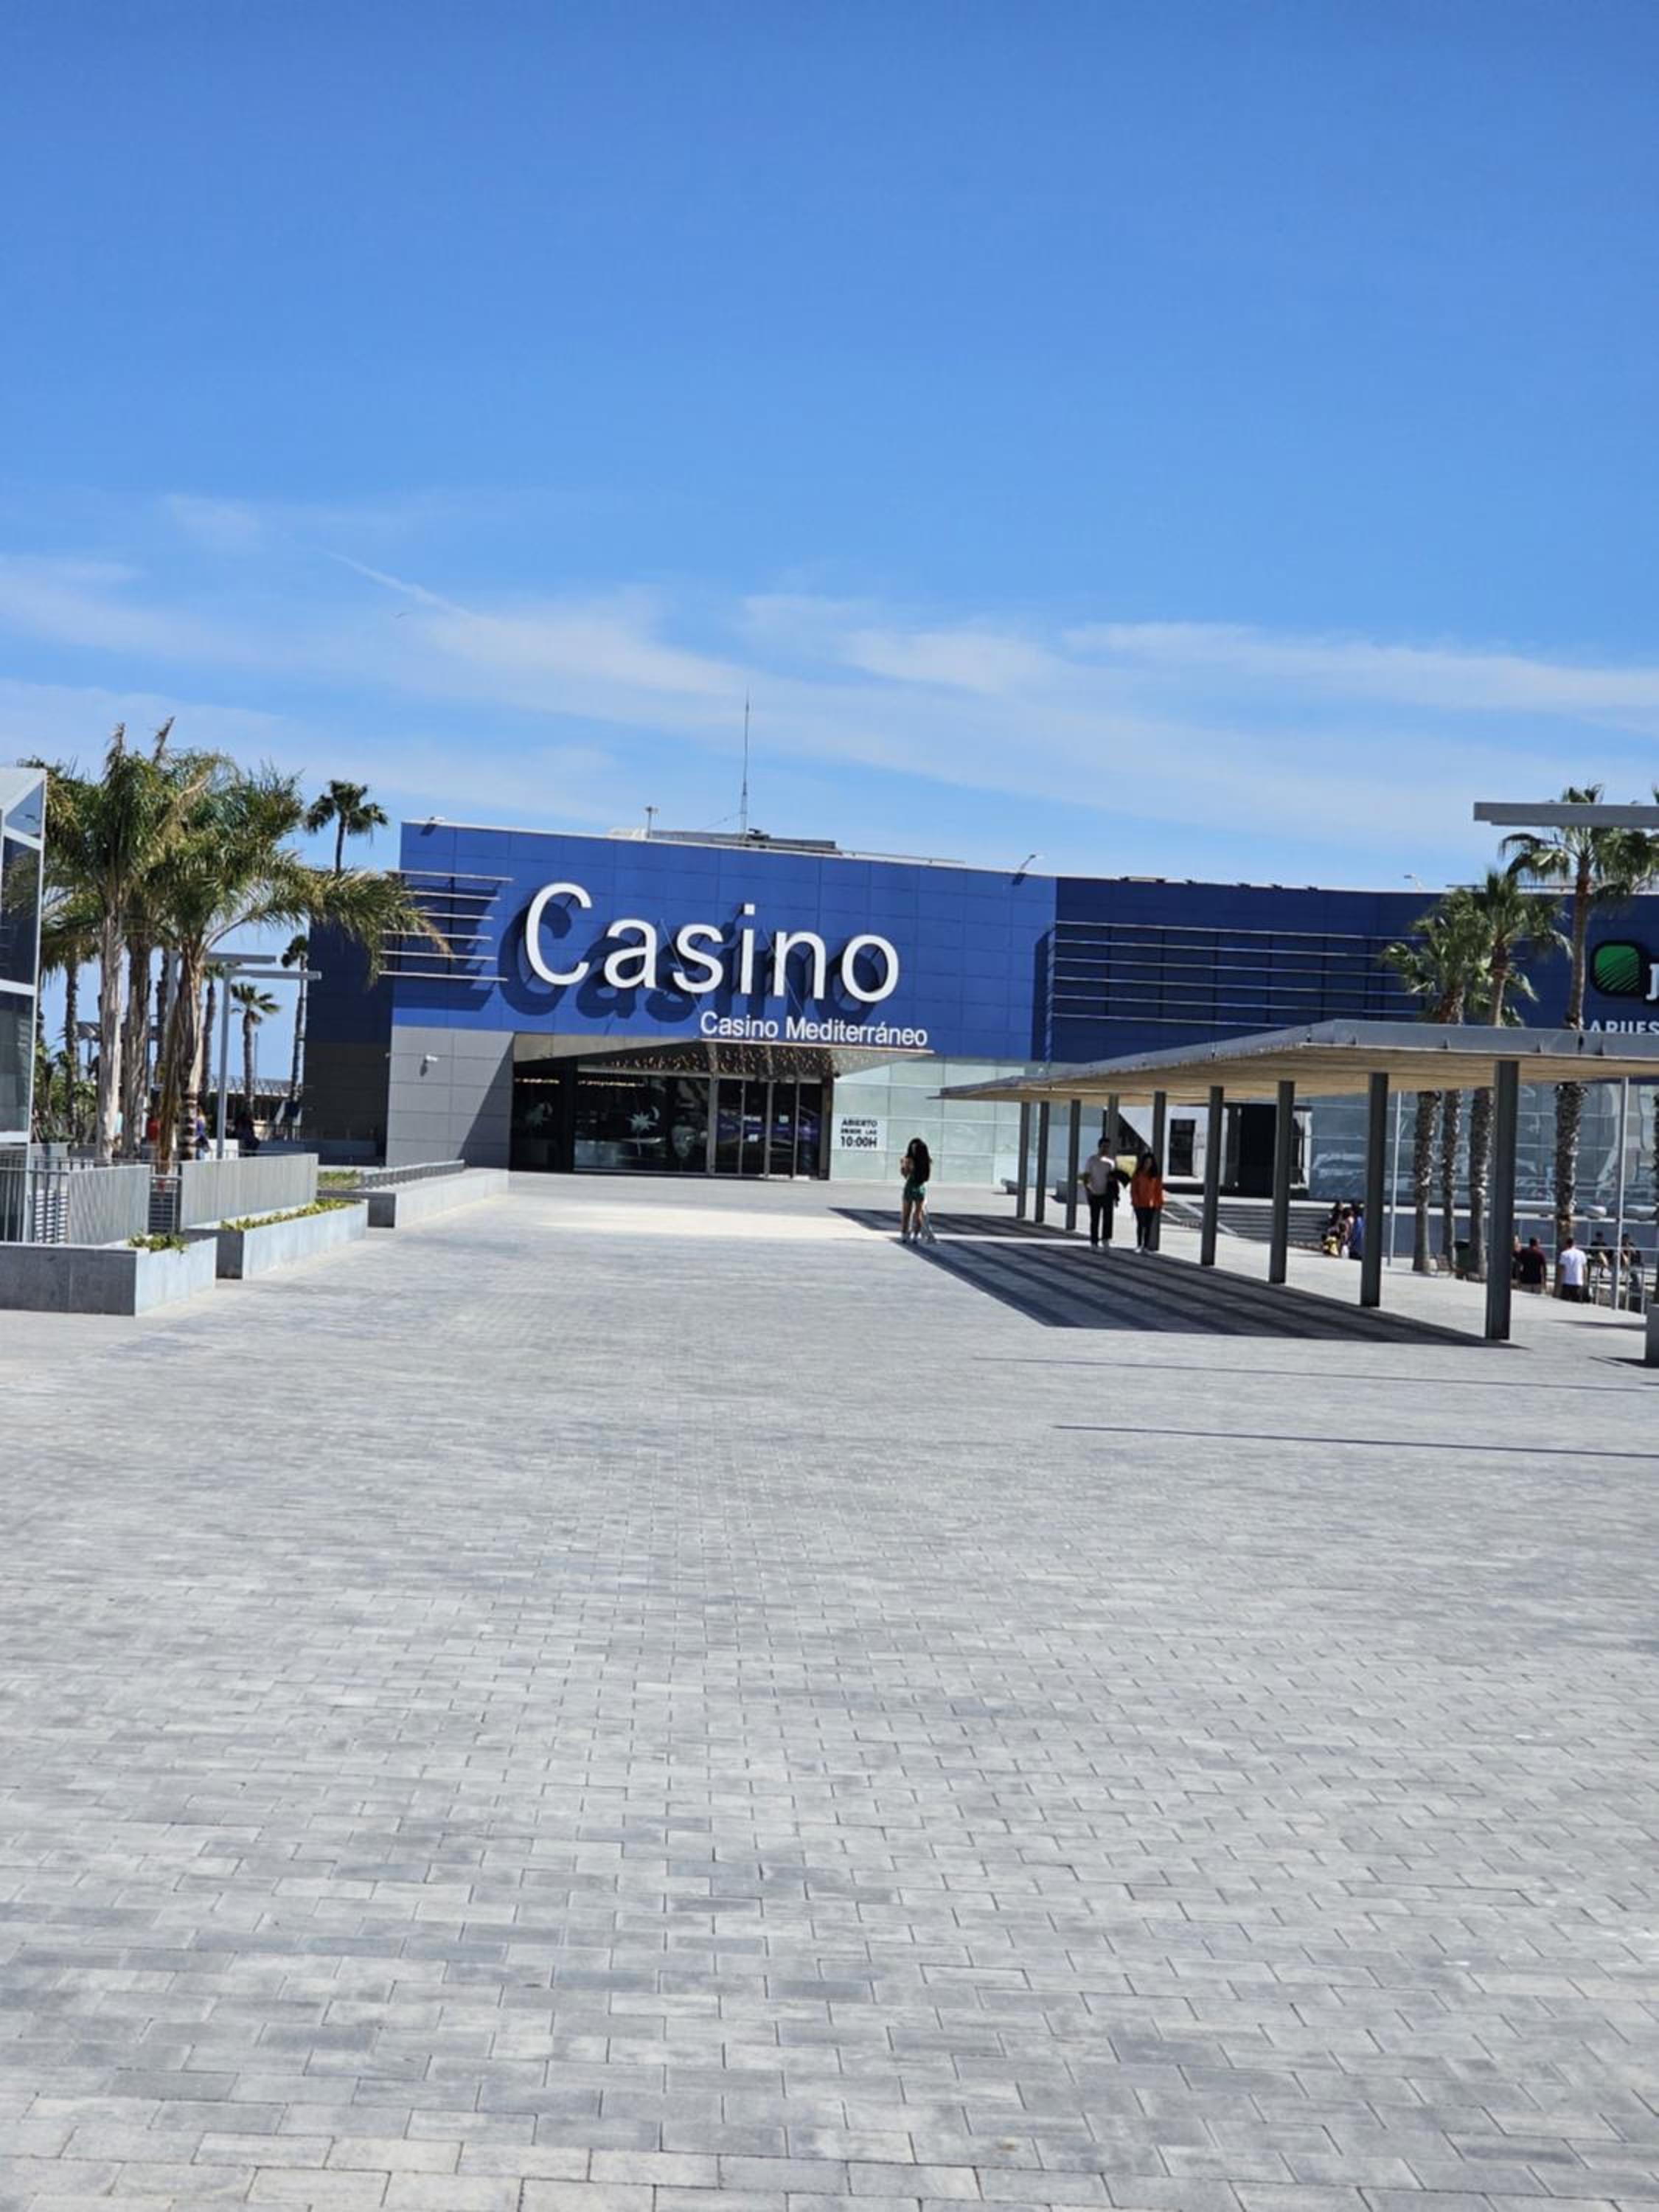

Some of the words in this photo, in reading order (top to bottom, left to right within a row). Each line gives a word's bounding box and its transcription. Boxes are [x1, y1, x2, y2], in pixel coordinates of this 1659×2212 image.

[524, 882, 900, 1004] Casino
[700, 1010, 779, 1038] Casino
[785, 1016, 928, 1047] Mediterráneo
[841, 1135, 877, 1148] 10:00H
